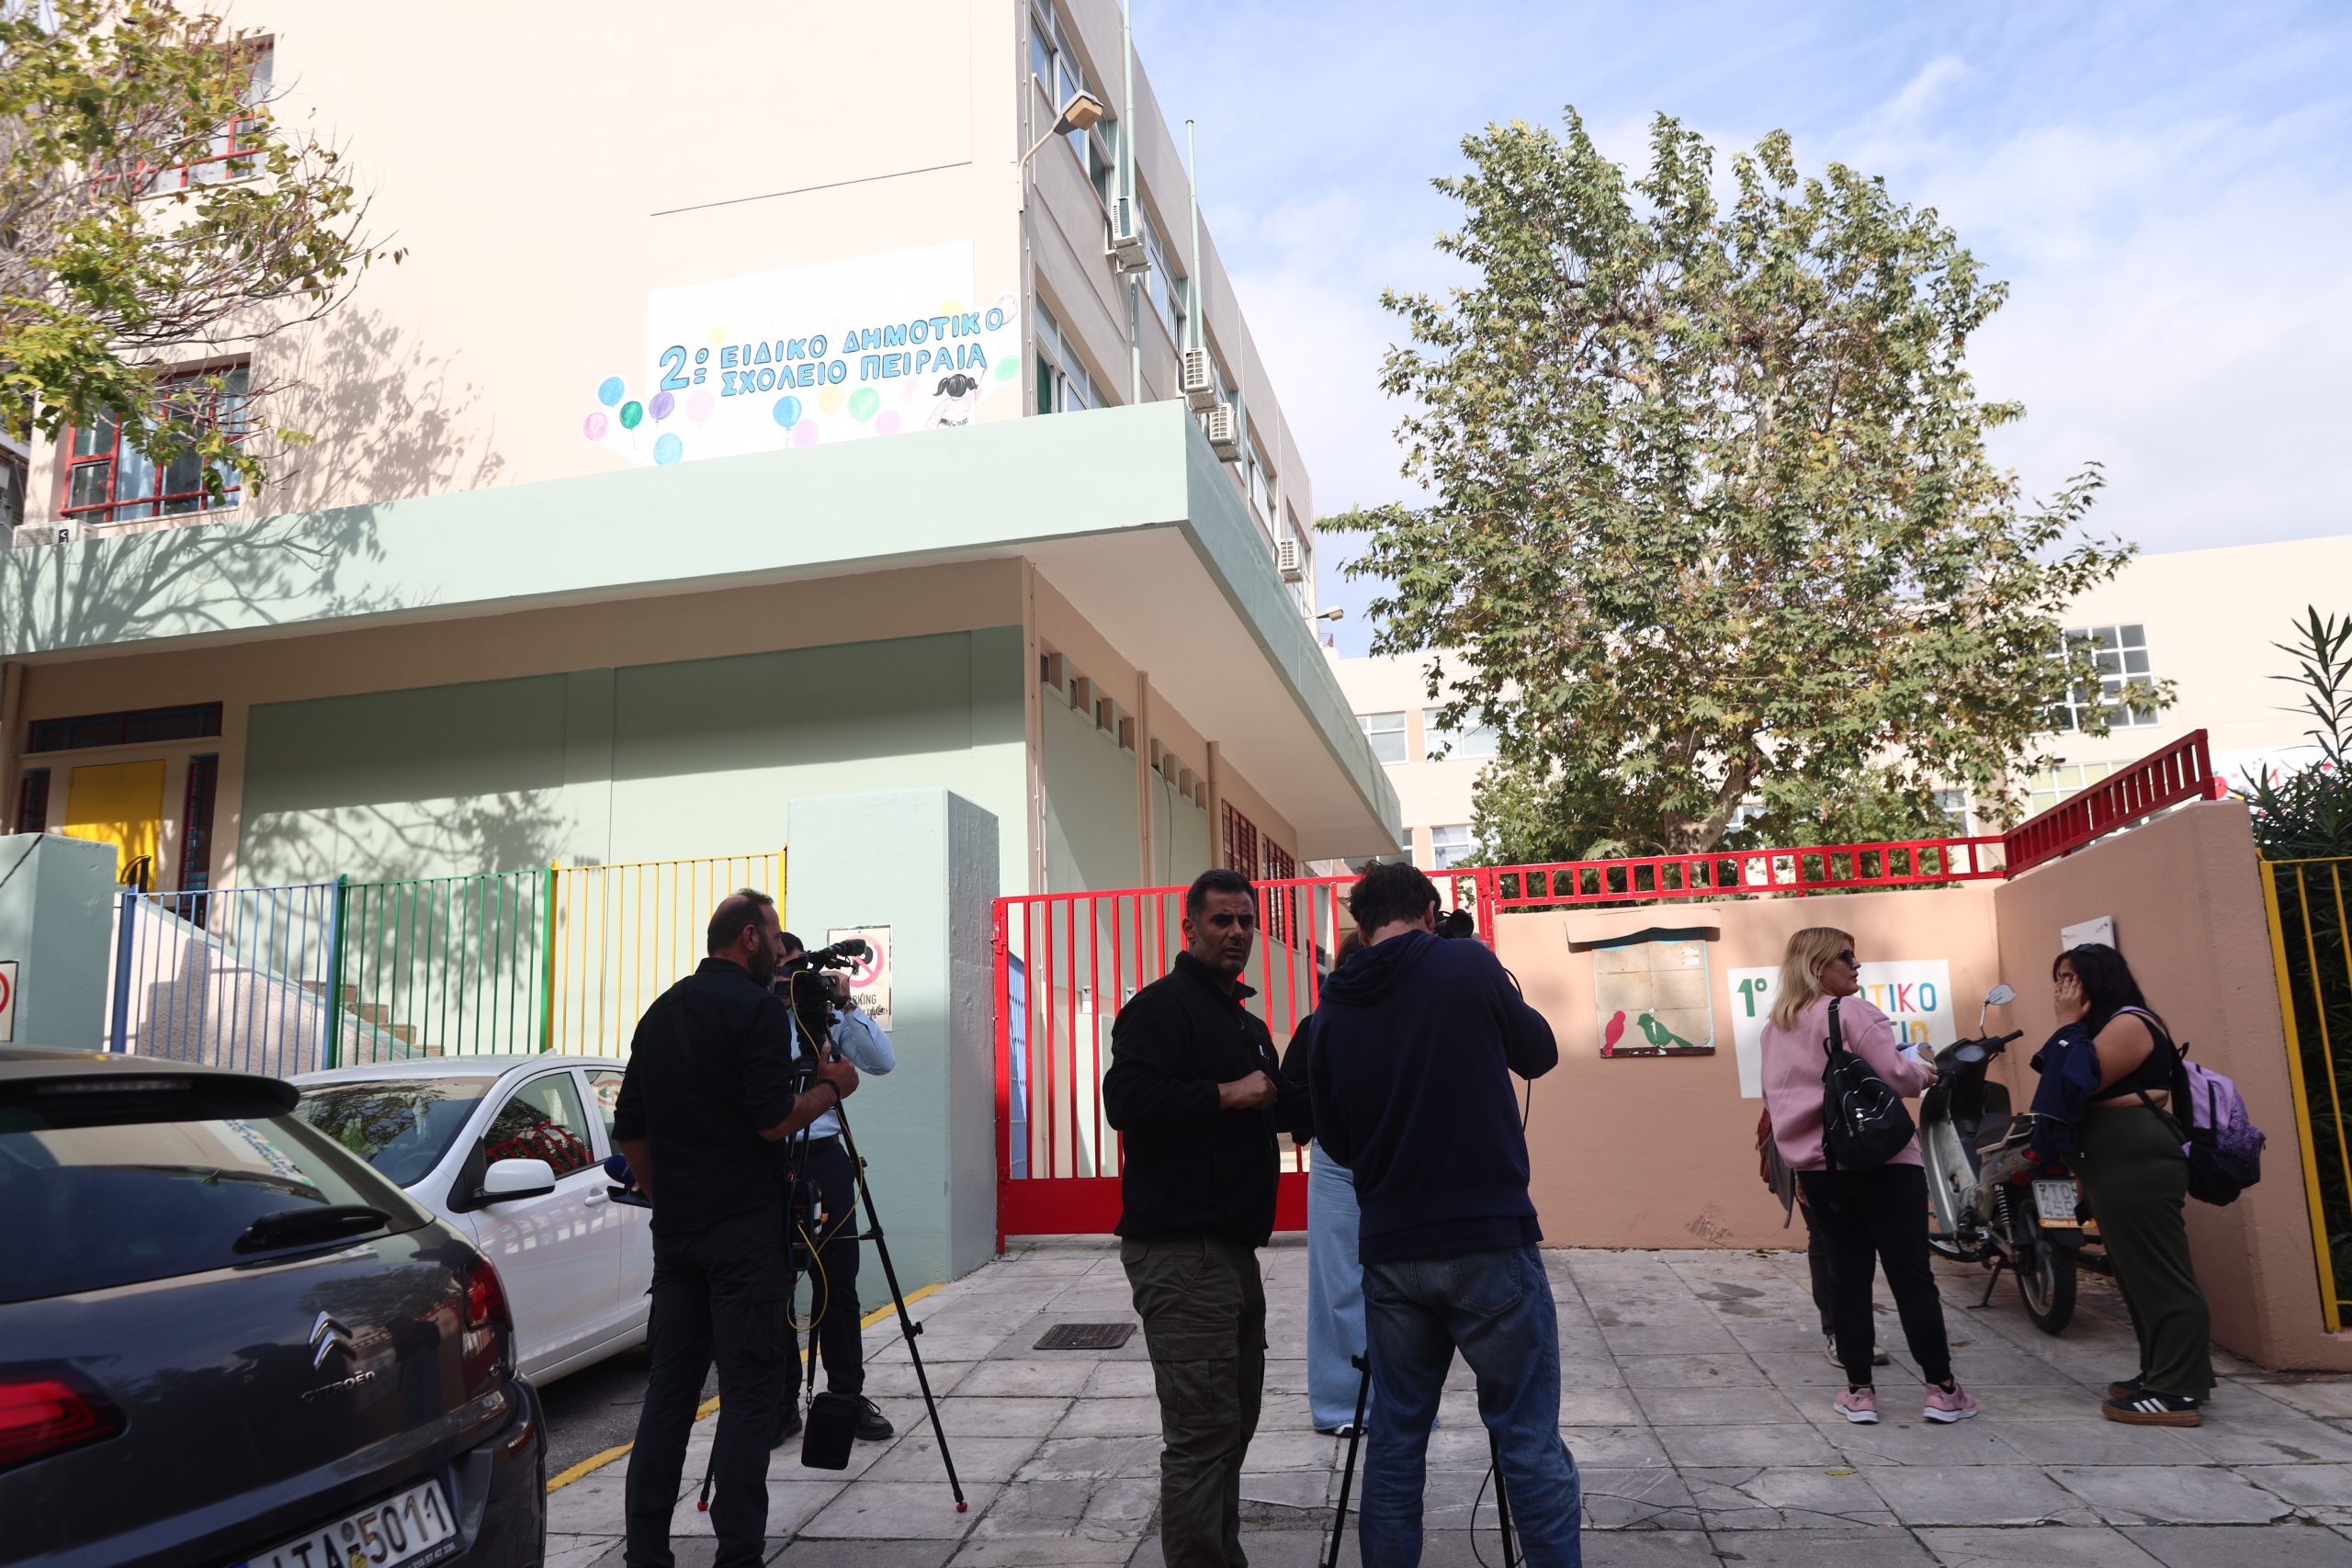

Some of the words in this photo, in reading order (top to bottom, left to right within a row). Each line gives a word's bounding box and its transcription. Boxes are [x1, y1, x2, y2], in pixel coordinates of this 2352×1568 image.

[720, 334, 828, 369] ΕΙΔΙΚΟ
[842, 308, 1003, 354] ΔΗΜΟΤΙΚΟ
[721, 359, 847, 397] ΣΧΟΛΕΙΟ
[861, 343, 988, 381] ΠΕΙΡΑΙΑ
